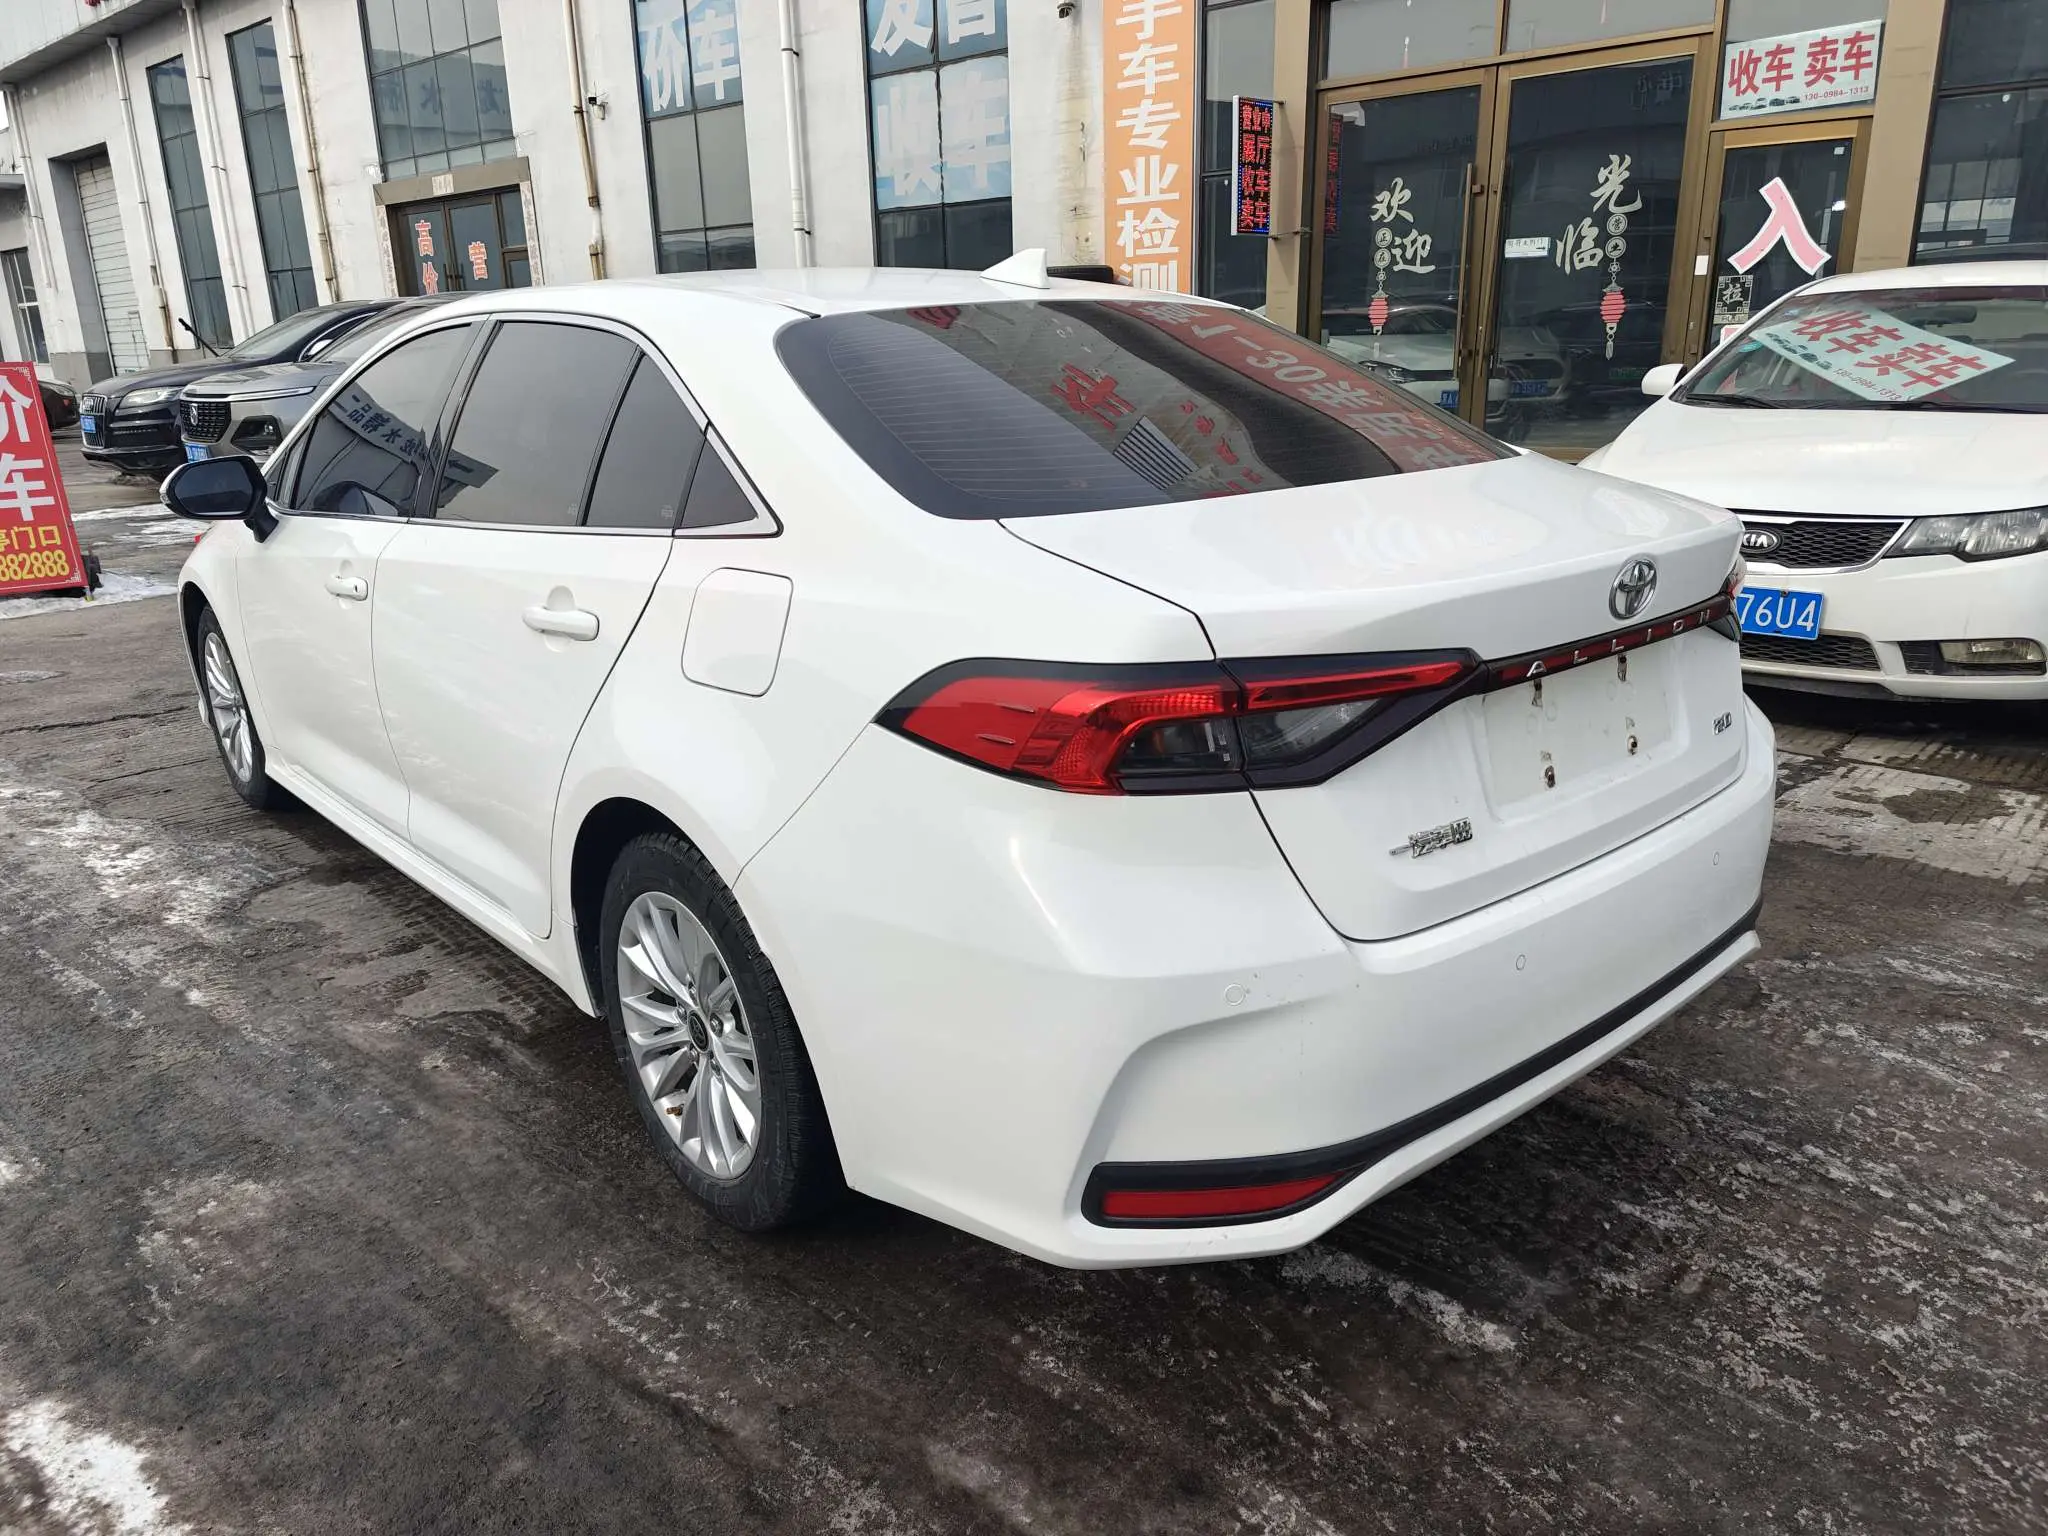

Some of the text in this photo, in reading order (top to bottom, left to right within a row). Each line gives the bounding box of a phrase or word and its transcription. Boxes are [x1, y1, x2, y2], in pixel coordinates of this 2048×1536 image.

[1728, 44, 1795, 96] 收车
[1804, 31, 1875, 88] 卖车
[1804, 86, 1869, 101] 130-0984-1313
[1370, 177, 1437, 274] 欢迎
[1556, 153, 1643, 275] 光临
[0, 453, 55, 521] 车
[1526, 610, 1711, 678] ALLION
[1739, 593, 1817, 632] 76U4
